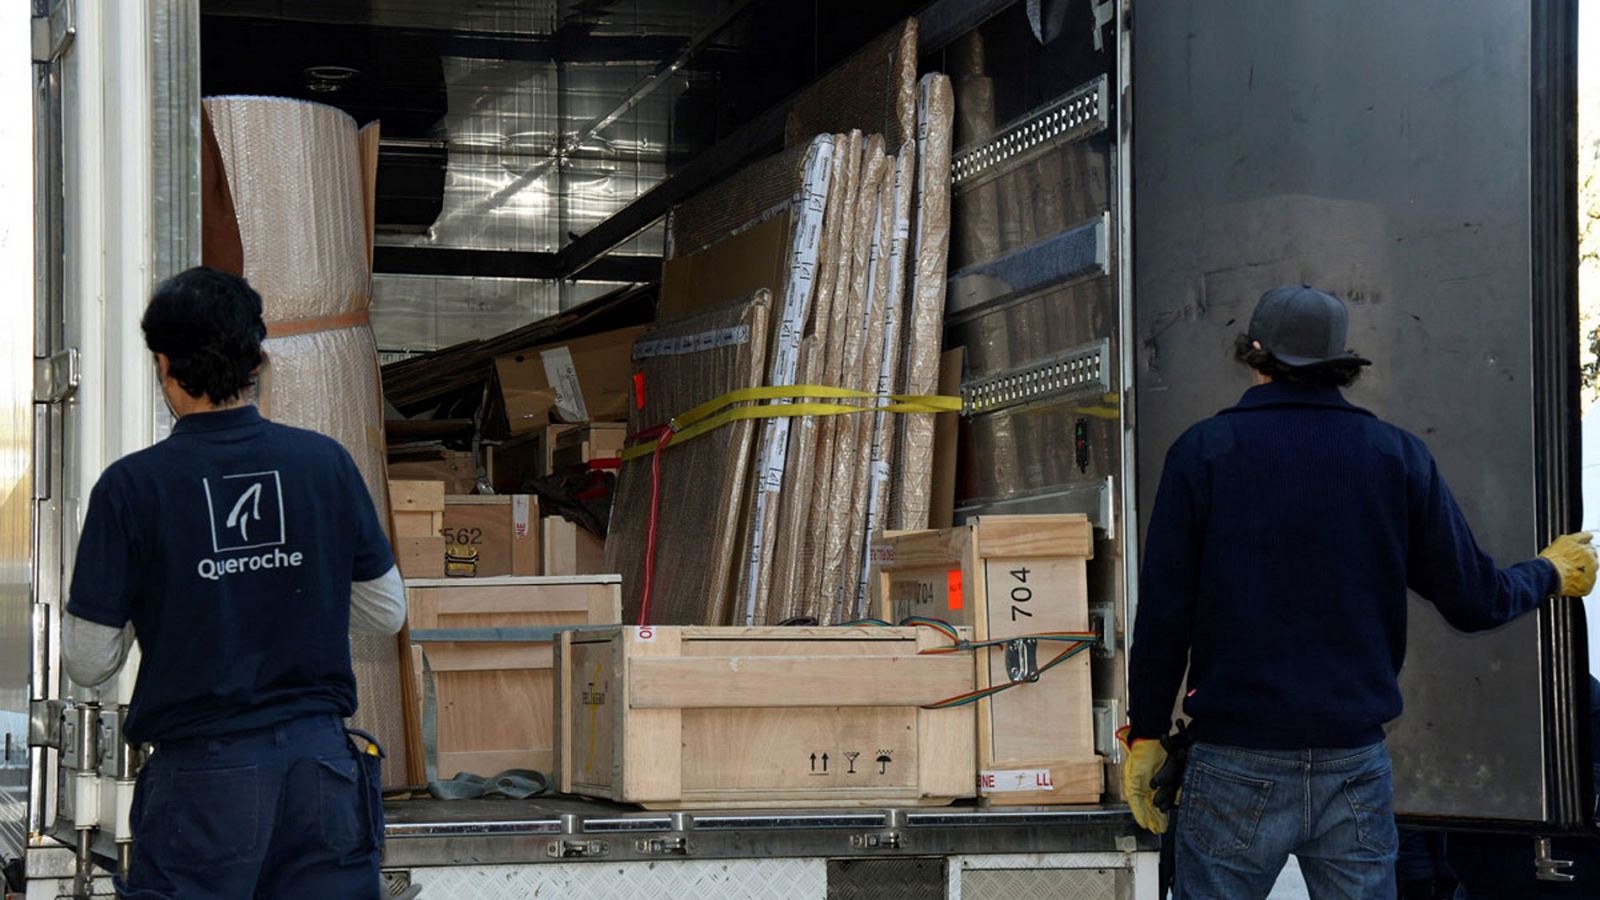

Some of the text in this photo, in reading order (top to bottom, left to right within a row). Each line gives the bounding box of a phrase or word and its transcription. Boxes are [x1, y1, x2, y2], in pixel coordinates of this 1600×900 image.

[443, 527, 483, 546] 562
[197, 547, 303, 580] Queroche
[916, 582, 934, 605] 704
[1008, 566, 1033, 622] 704
